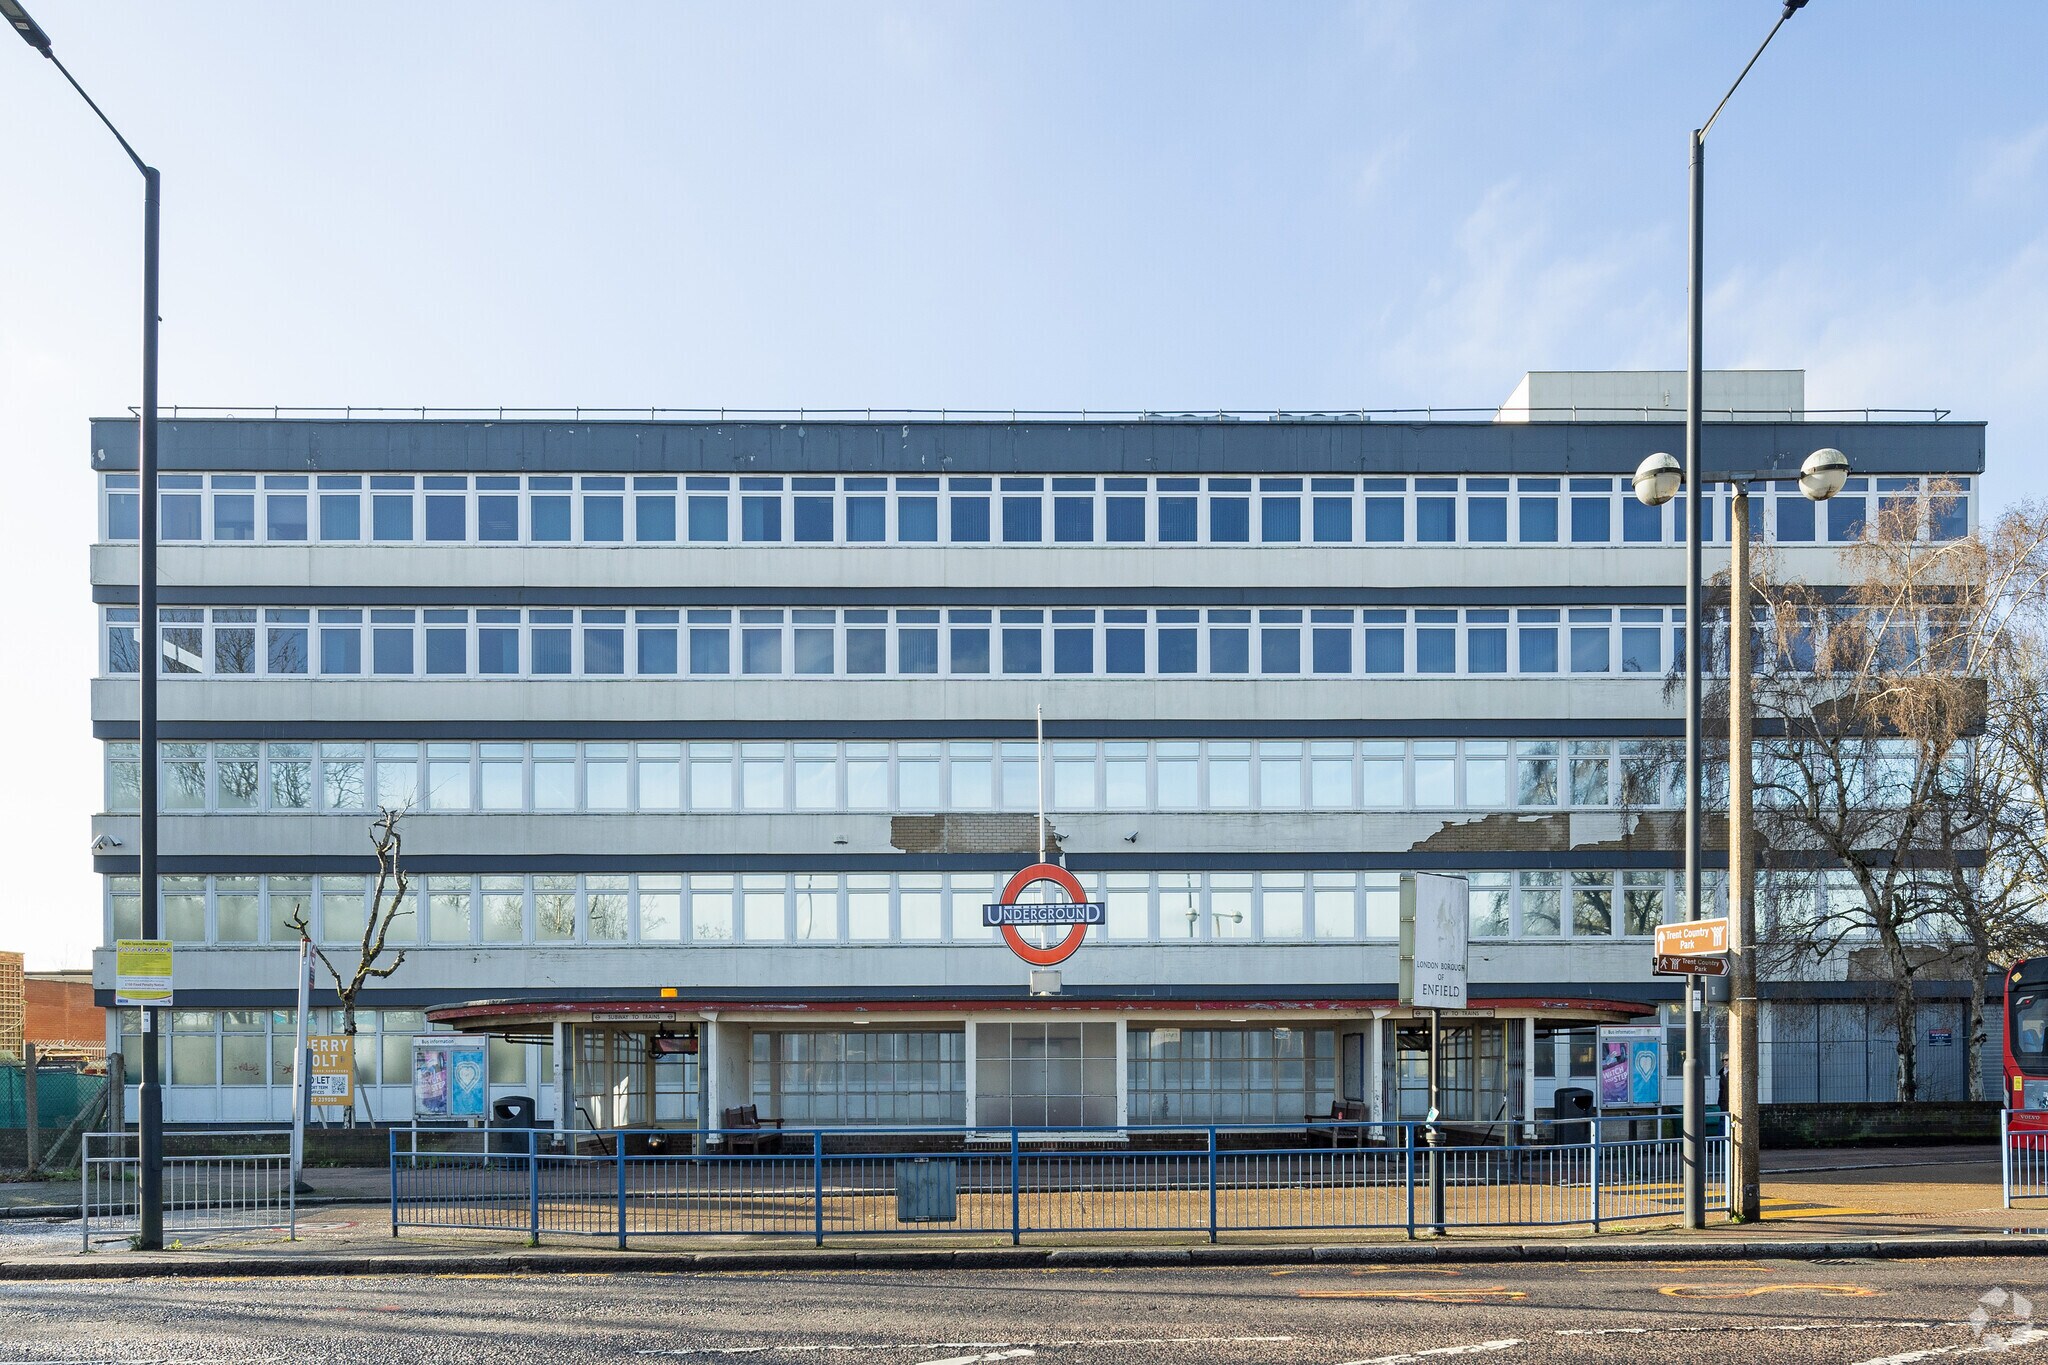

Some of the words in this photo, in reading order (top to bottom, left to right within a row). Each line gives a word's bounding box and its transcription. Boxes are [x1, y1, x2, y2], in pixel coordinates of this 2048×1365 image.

[987, 904, 1100, 924] UNDERGROUND
[1666, 930, 1682, 940] Trent
[1684, 928, 1709, 938] Country
[1680, 940, 1694, 950] Park
[1417, 961, 1439, 969] LONDON
[1441, 963, 1465, 972] BOROUGH
[1697, 959, 1720, 967] Country
[1422, 984, 1460, 997] ENFIELD
[307, 1040, 348, 1052] ERRY
[312, 1054, 338, 1066] OLT
[1602, 1066, 1624, 1079] WATCH
[1614, 1072, 1628, 1083] STEP
[316, 1076, 330, 1084] LET
